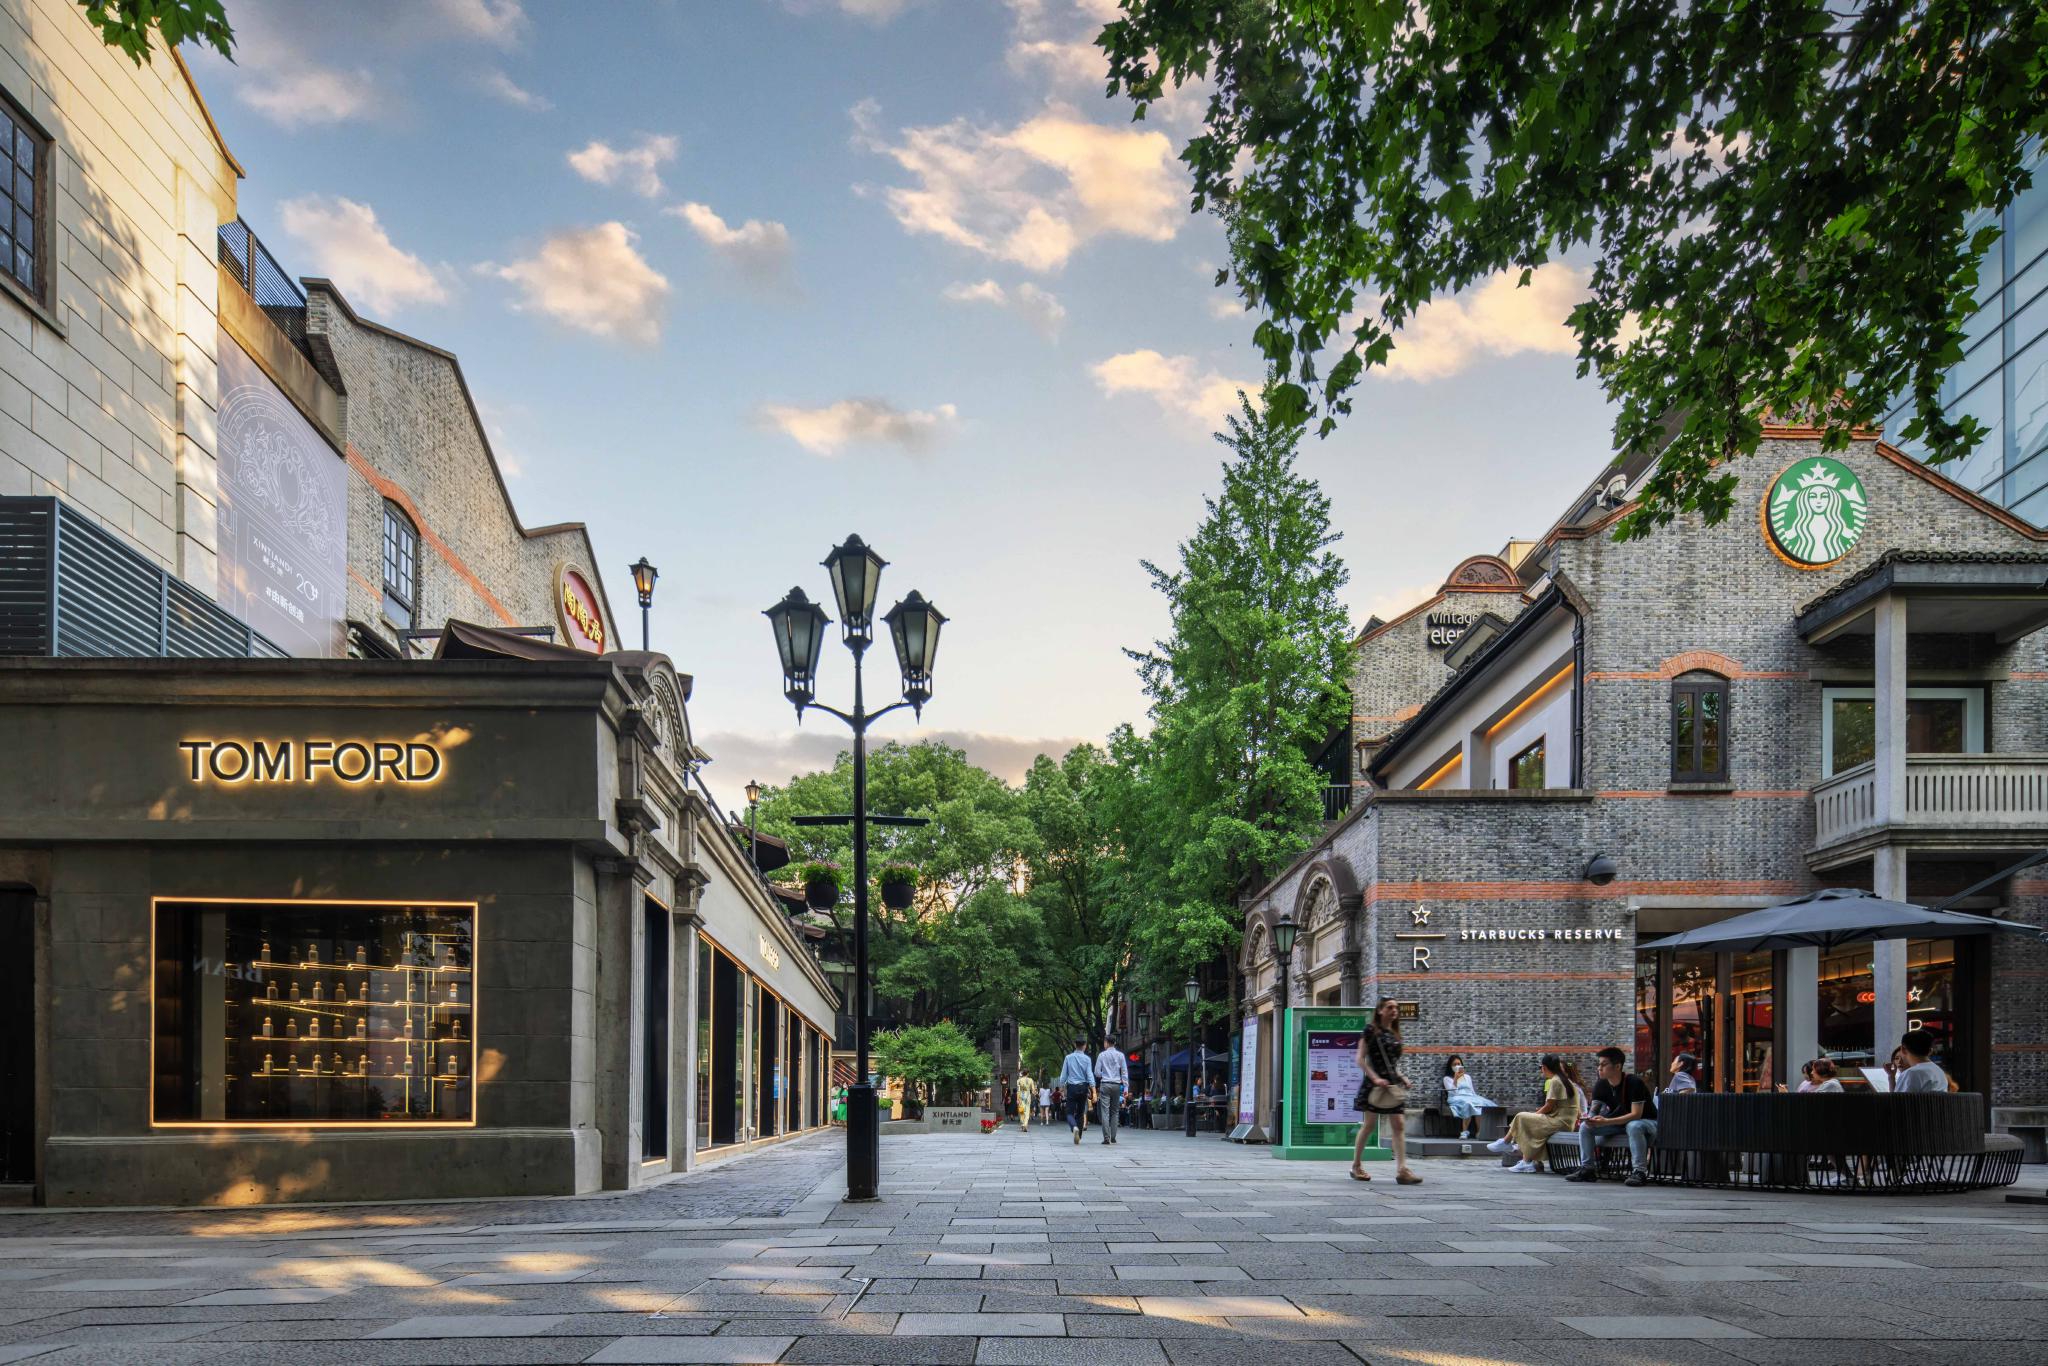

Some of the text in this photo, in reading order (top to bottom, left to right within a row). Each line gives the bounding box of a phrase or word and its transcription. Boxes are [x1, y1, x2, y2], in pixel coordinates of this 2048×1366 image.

[253, 536, 293, 574] XINTIANDI
[179, 741, 441, 783] TOM FORD
[1461, 929, 1622, 940] STARBUCKS RESERVE
[1413, 946, 1430, 969] R
